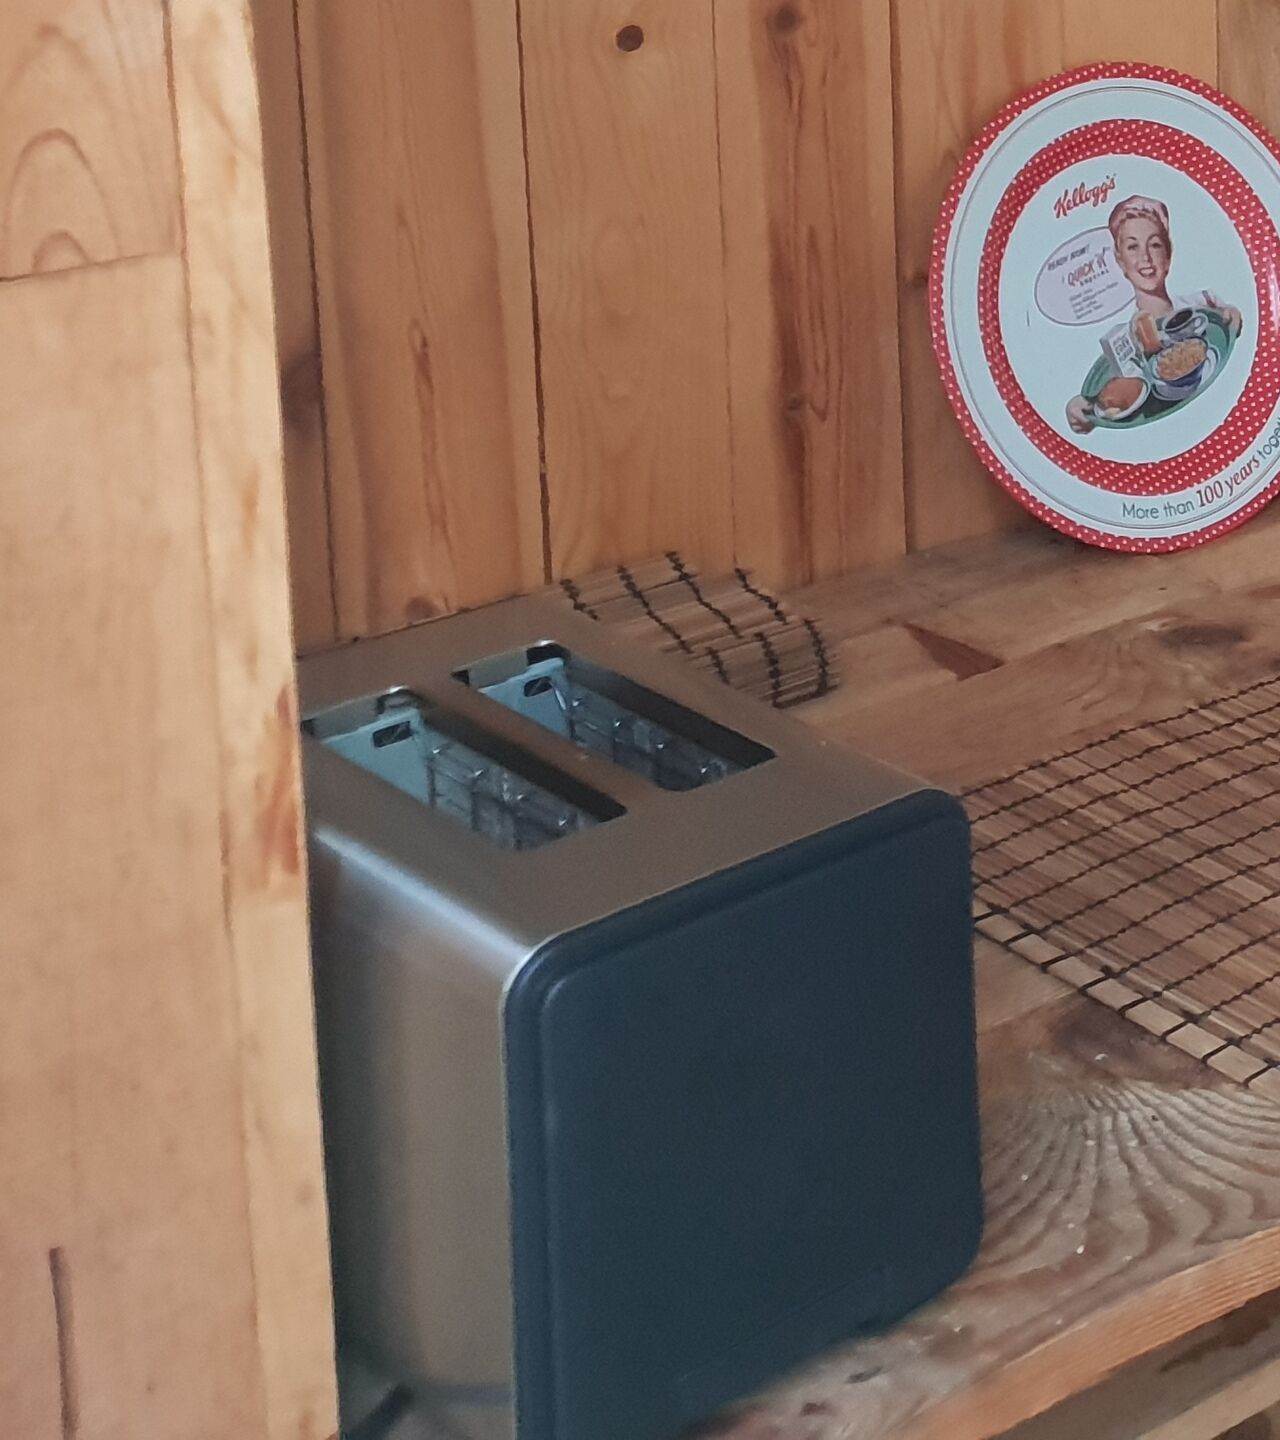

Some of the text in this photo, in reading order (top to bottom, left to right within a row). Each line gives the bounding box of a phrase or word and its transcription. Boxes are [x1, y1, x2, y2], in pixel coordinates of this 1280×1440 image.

[1053, 174, 1116, 219] Kellogg's
[1122, 501, 1160, 520] More
[1163, 499, 1195, 518] than
[1195, 481, 1224, 508] 100
[1225, 455, 1261, 497] years
